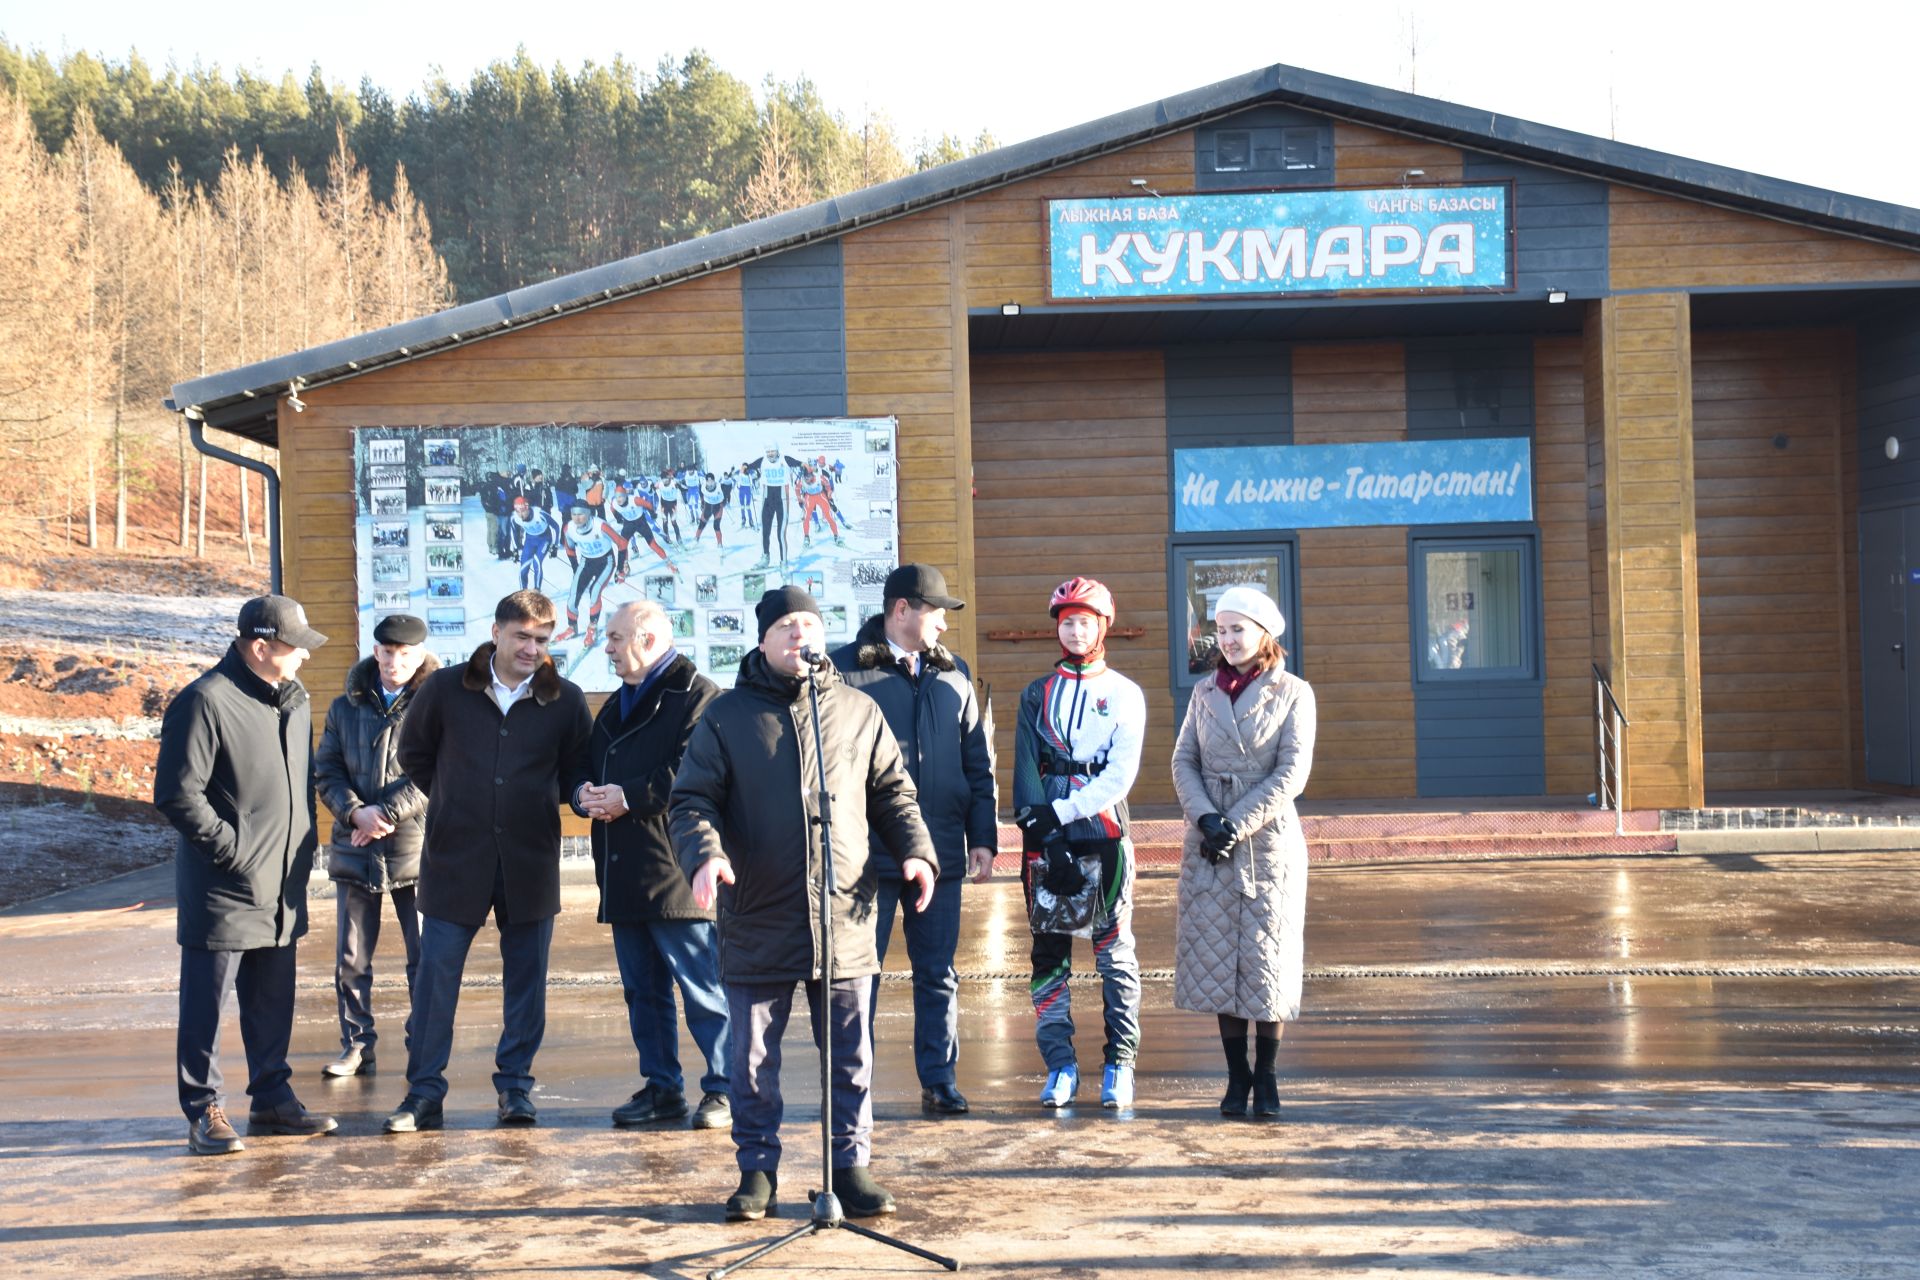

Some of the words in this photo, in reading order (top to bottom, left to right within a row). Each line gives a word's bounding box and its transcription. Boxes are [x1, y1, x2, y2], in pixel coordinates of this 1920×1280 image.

[1059, 207, 1132, 223] ЛЫЖНАЯ
[1138, 206, 1180, 221] БАЗА
[1429, 196, 1496, 212] БАЗАСЫ
[1080, 221, 1476, 286] КУКМАРА
[1182, 471, 1220, 507] На
